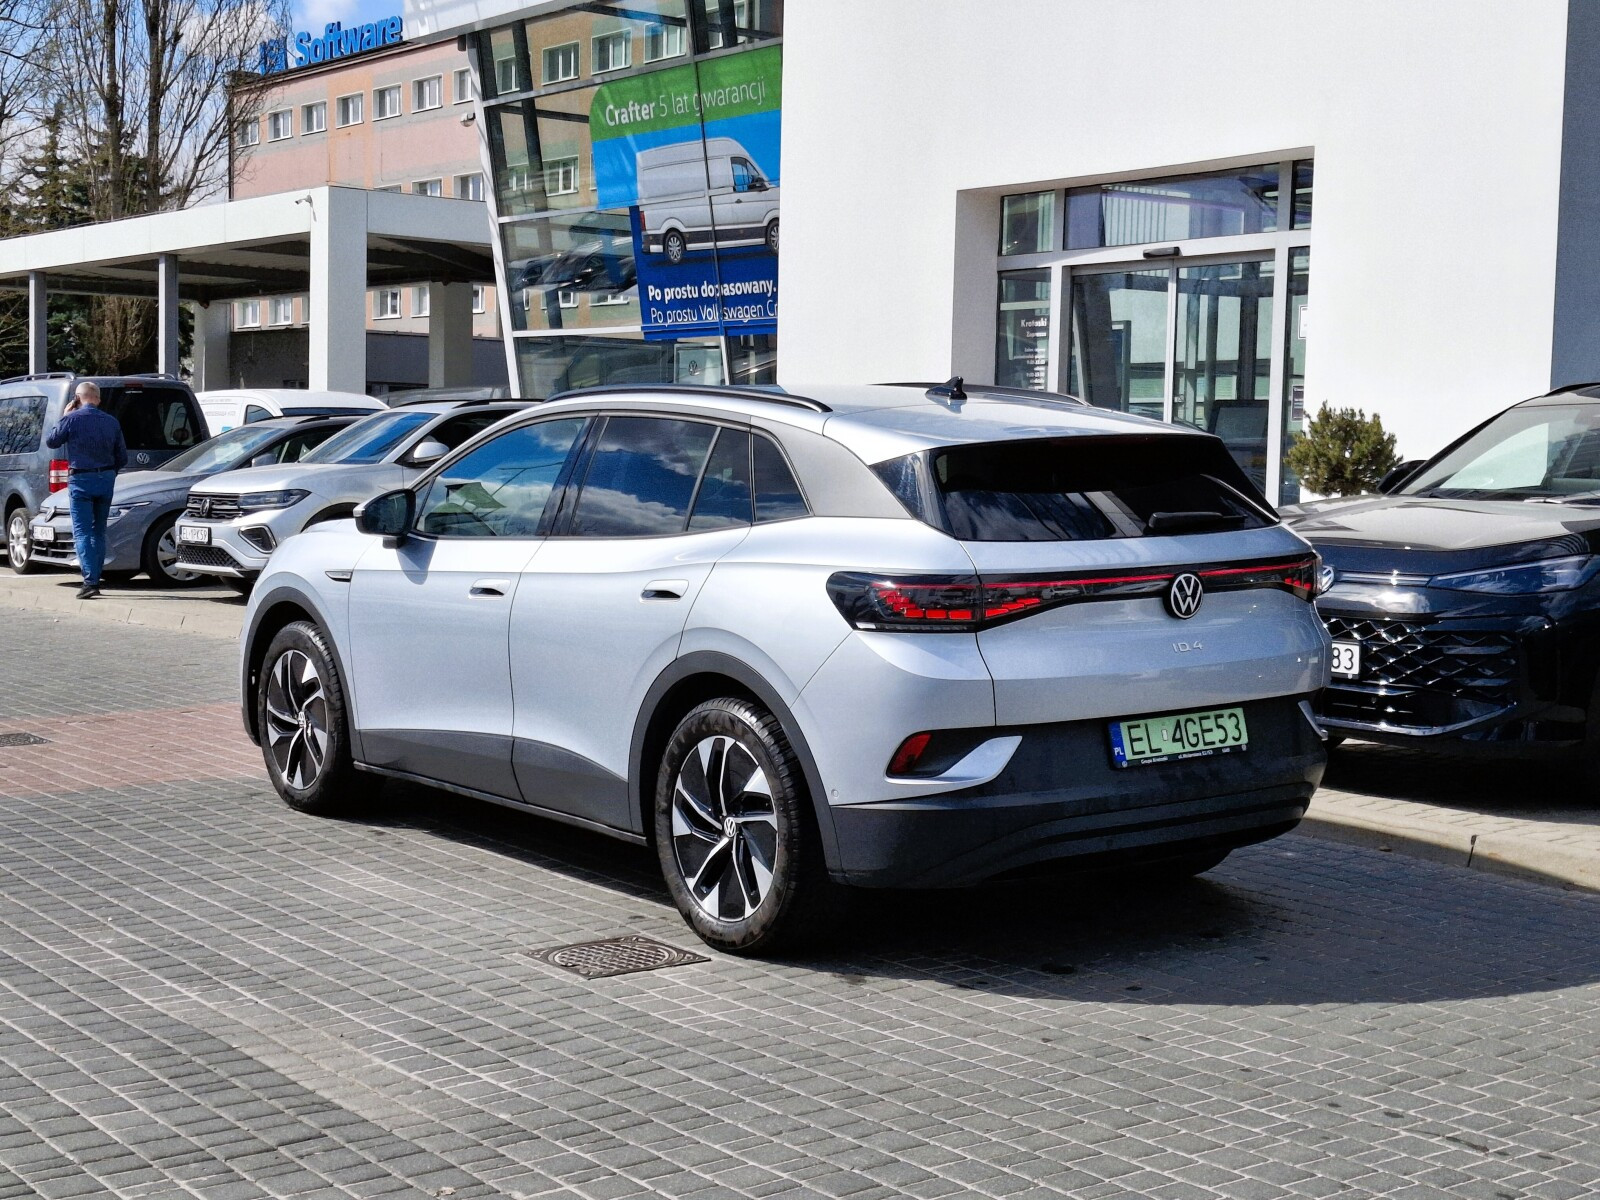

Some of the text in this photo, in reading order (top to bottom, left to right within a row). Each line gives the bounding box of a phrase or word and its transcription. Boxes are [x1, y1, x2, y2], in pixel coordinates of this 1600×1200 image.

[295, 15, 403, 67] Software
[605, 75, 766, 127] Crafter 5 lat gwarancji
[648, 284, 662, 301] Po
[664, 283, 699, 304] prostu
[650, 307, 664, 324] Po
[667, 307, 698, 327] prostu
[1126, 712, 1243, 756] EL 4GE53
[1114, 746, 1125, 757] PL
